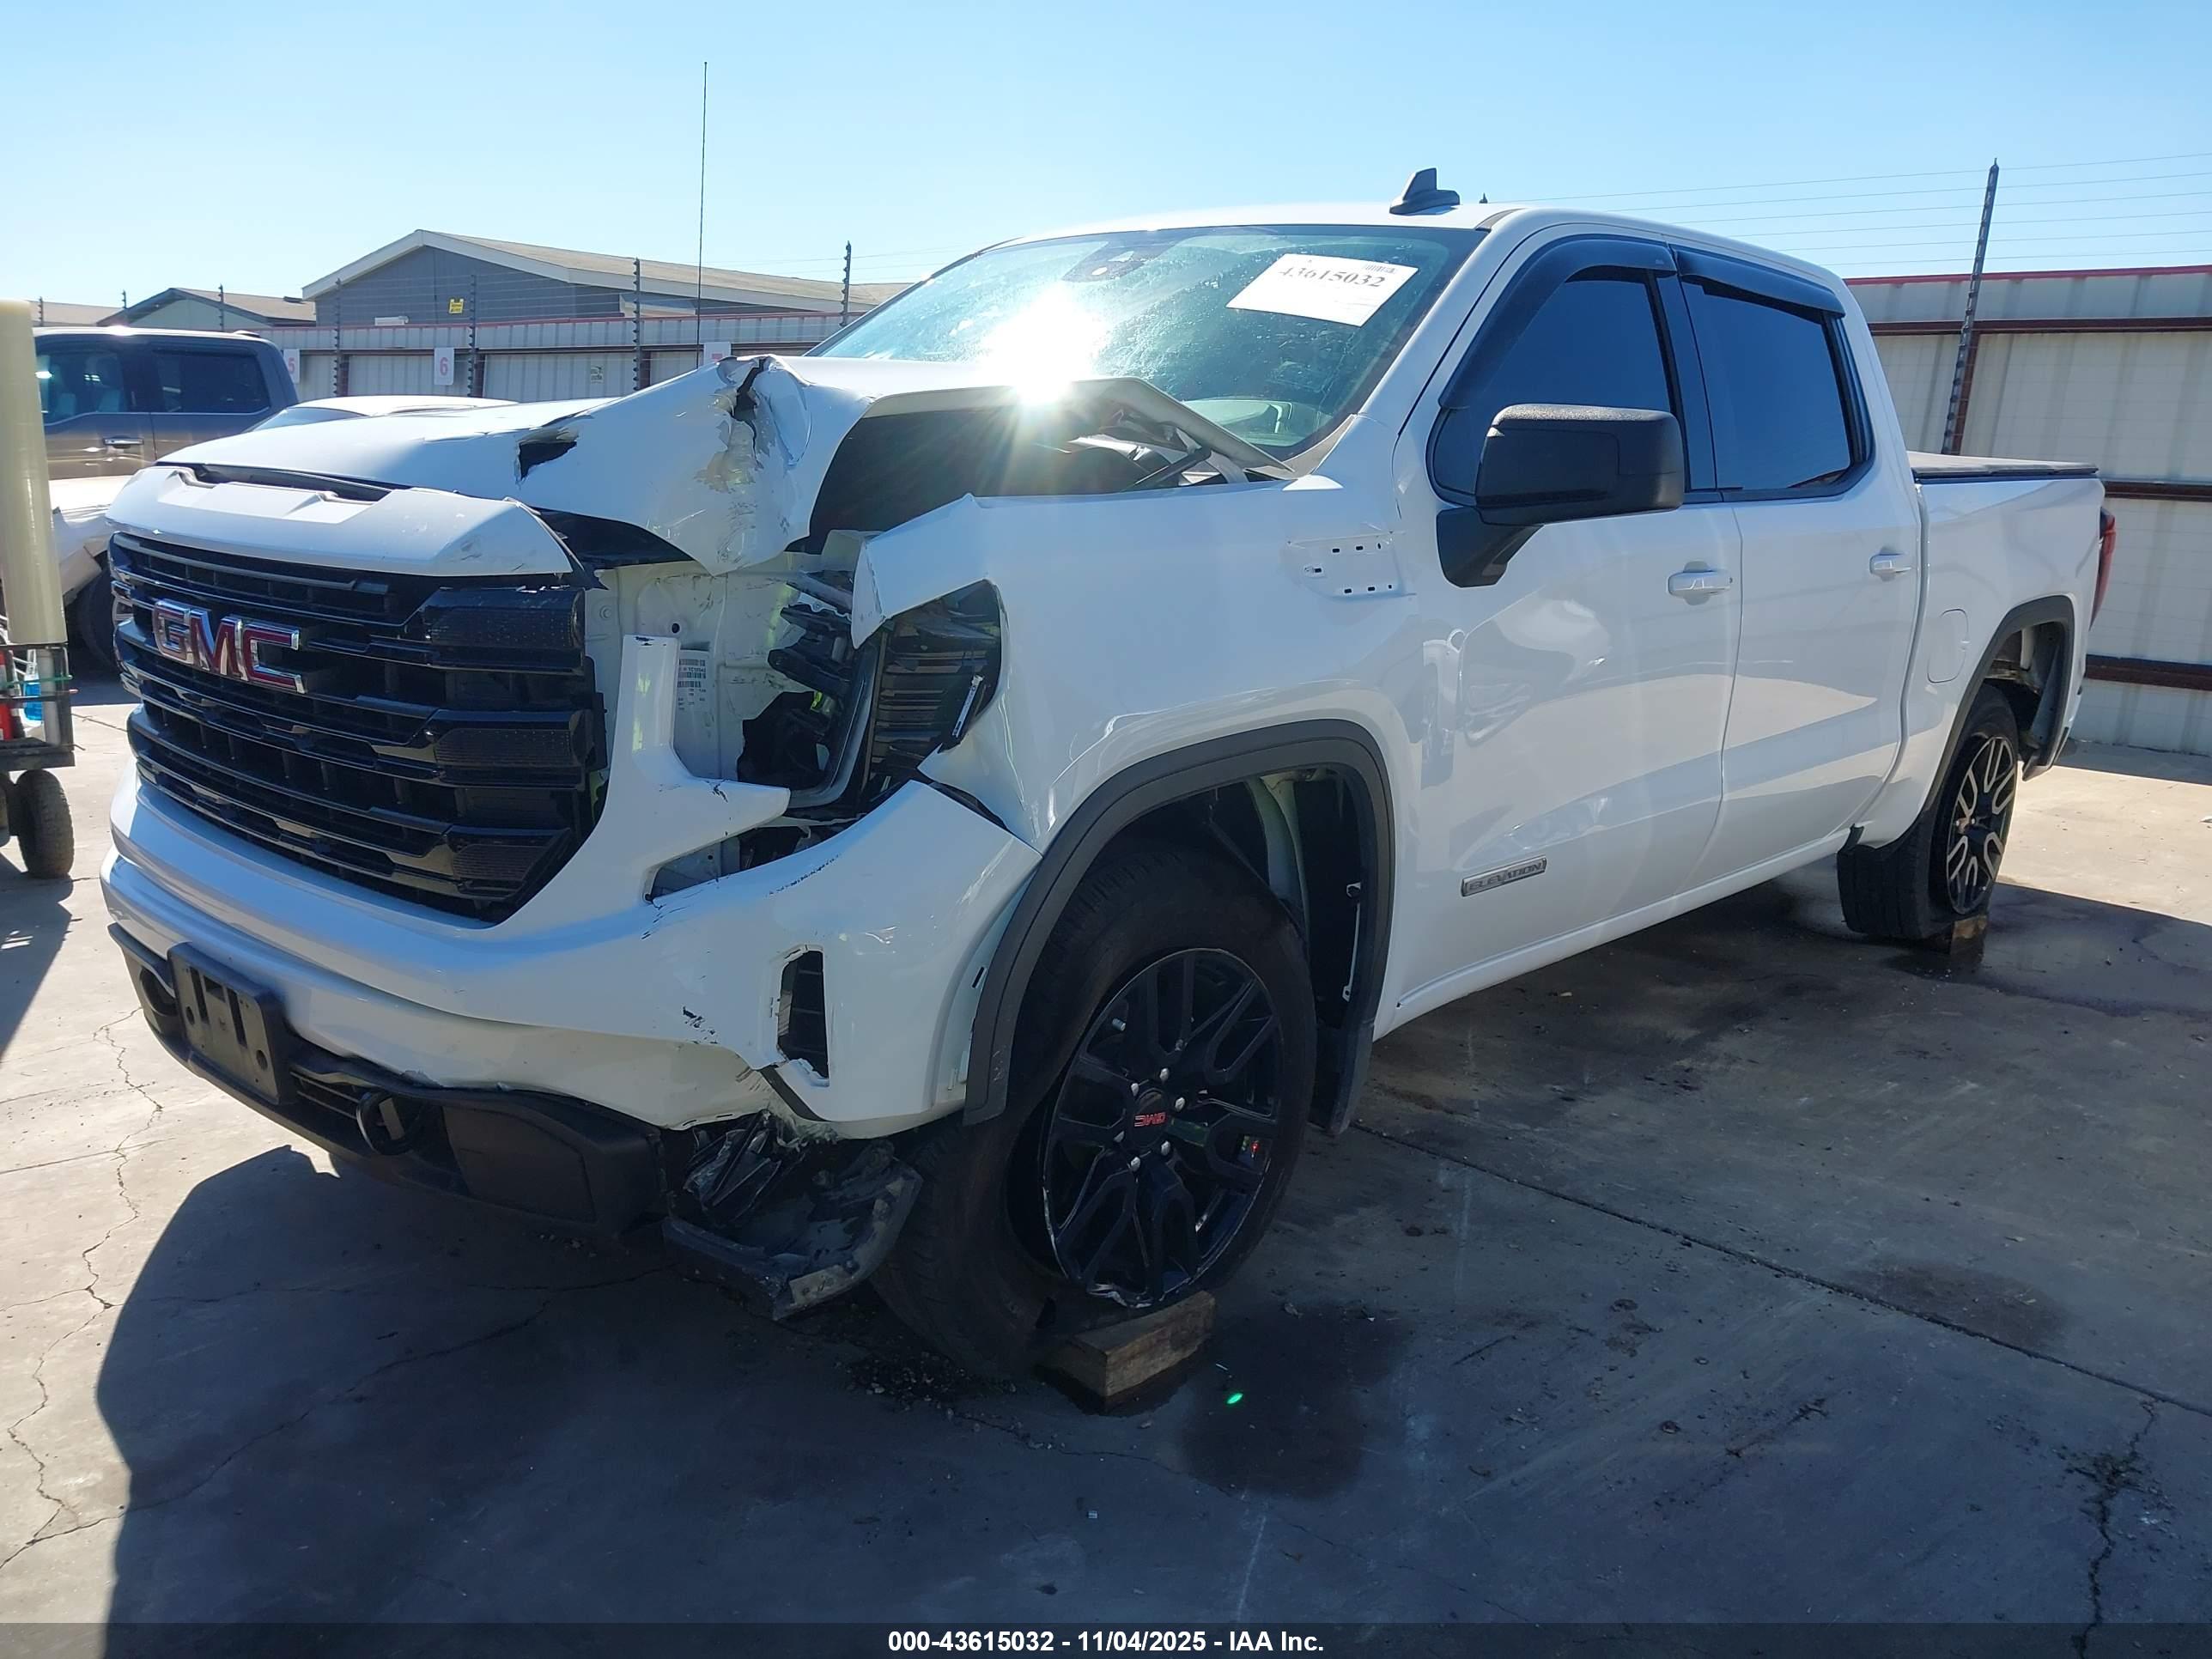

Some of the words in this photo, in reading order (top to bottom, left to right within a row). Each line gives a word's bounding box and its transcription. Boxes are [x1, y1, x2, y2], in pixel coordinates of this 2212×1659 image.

[440, 356, 449, 376] 6
[152, 598, 307, 695] GMC
[1468, 862, 1543, 890] ELEVATION
[1133, 1111, 1167, 1127] GMC
